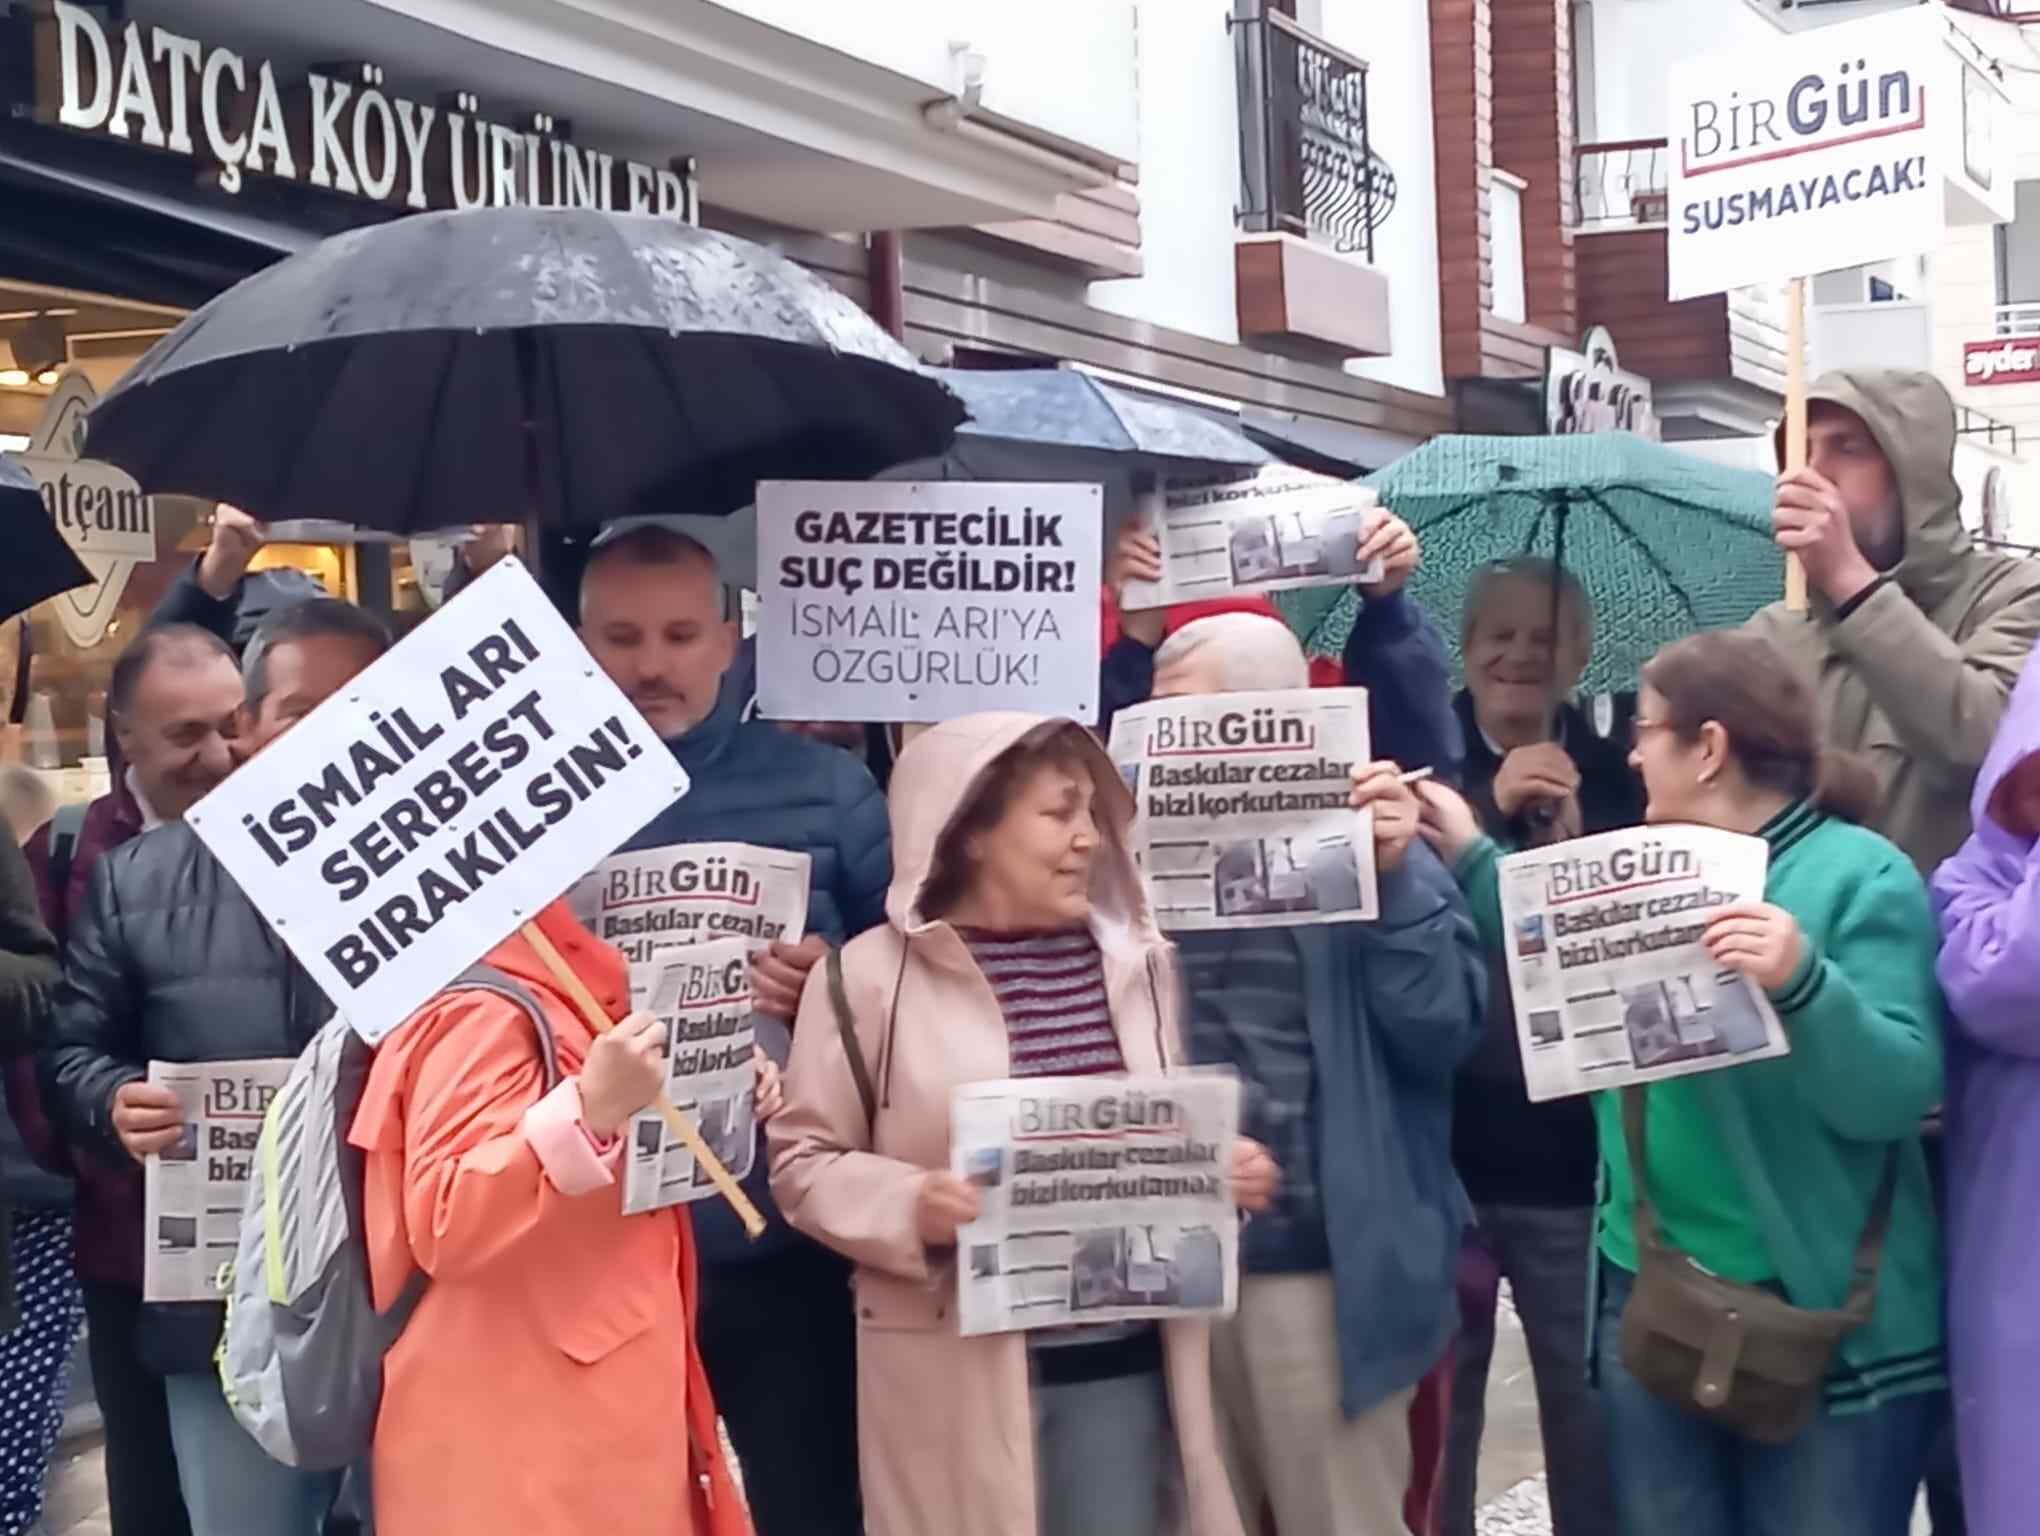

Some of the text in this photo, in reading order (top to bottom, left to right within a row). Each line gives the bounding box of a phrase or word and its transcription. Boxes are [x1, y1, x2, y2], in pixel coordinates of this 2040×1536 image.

[54, 0, 296, 194] DATÇA
[308, 63, 436, 208] KÖY
[1683, 156, 1926, 234] SUSMAYACAK!
[40, 471, 151, 542] atçam
[795, 506, 1063, 547] GAZETECİLİK
[779, 551, 1076, 595] SUÇ DEĞİLDİR!
[791, 600, 1061, 641] İSMAİL ARI'YA
[812, 643, 1040, 686] ÖZGÜRLÜK!
[242, 617, 541, 867] İSMAİL ARI
[321, 690, 555, 901] SERBEST
[1149, 761, 1255, 788] Baskılar
[1148, 792, 1194, 818] bizi
[324, 716, 644, 990] BIRAKILSIN!
